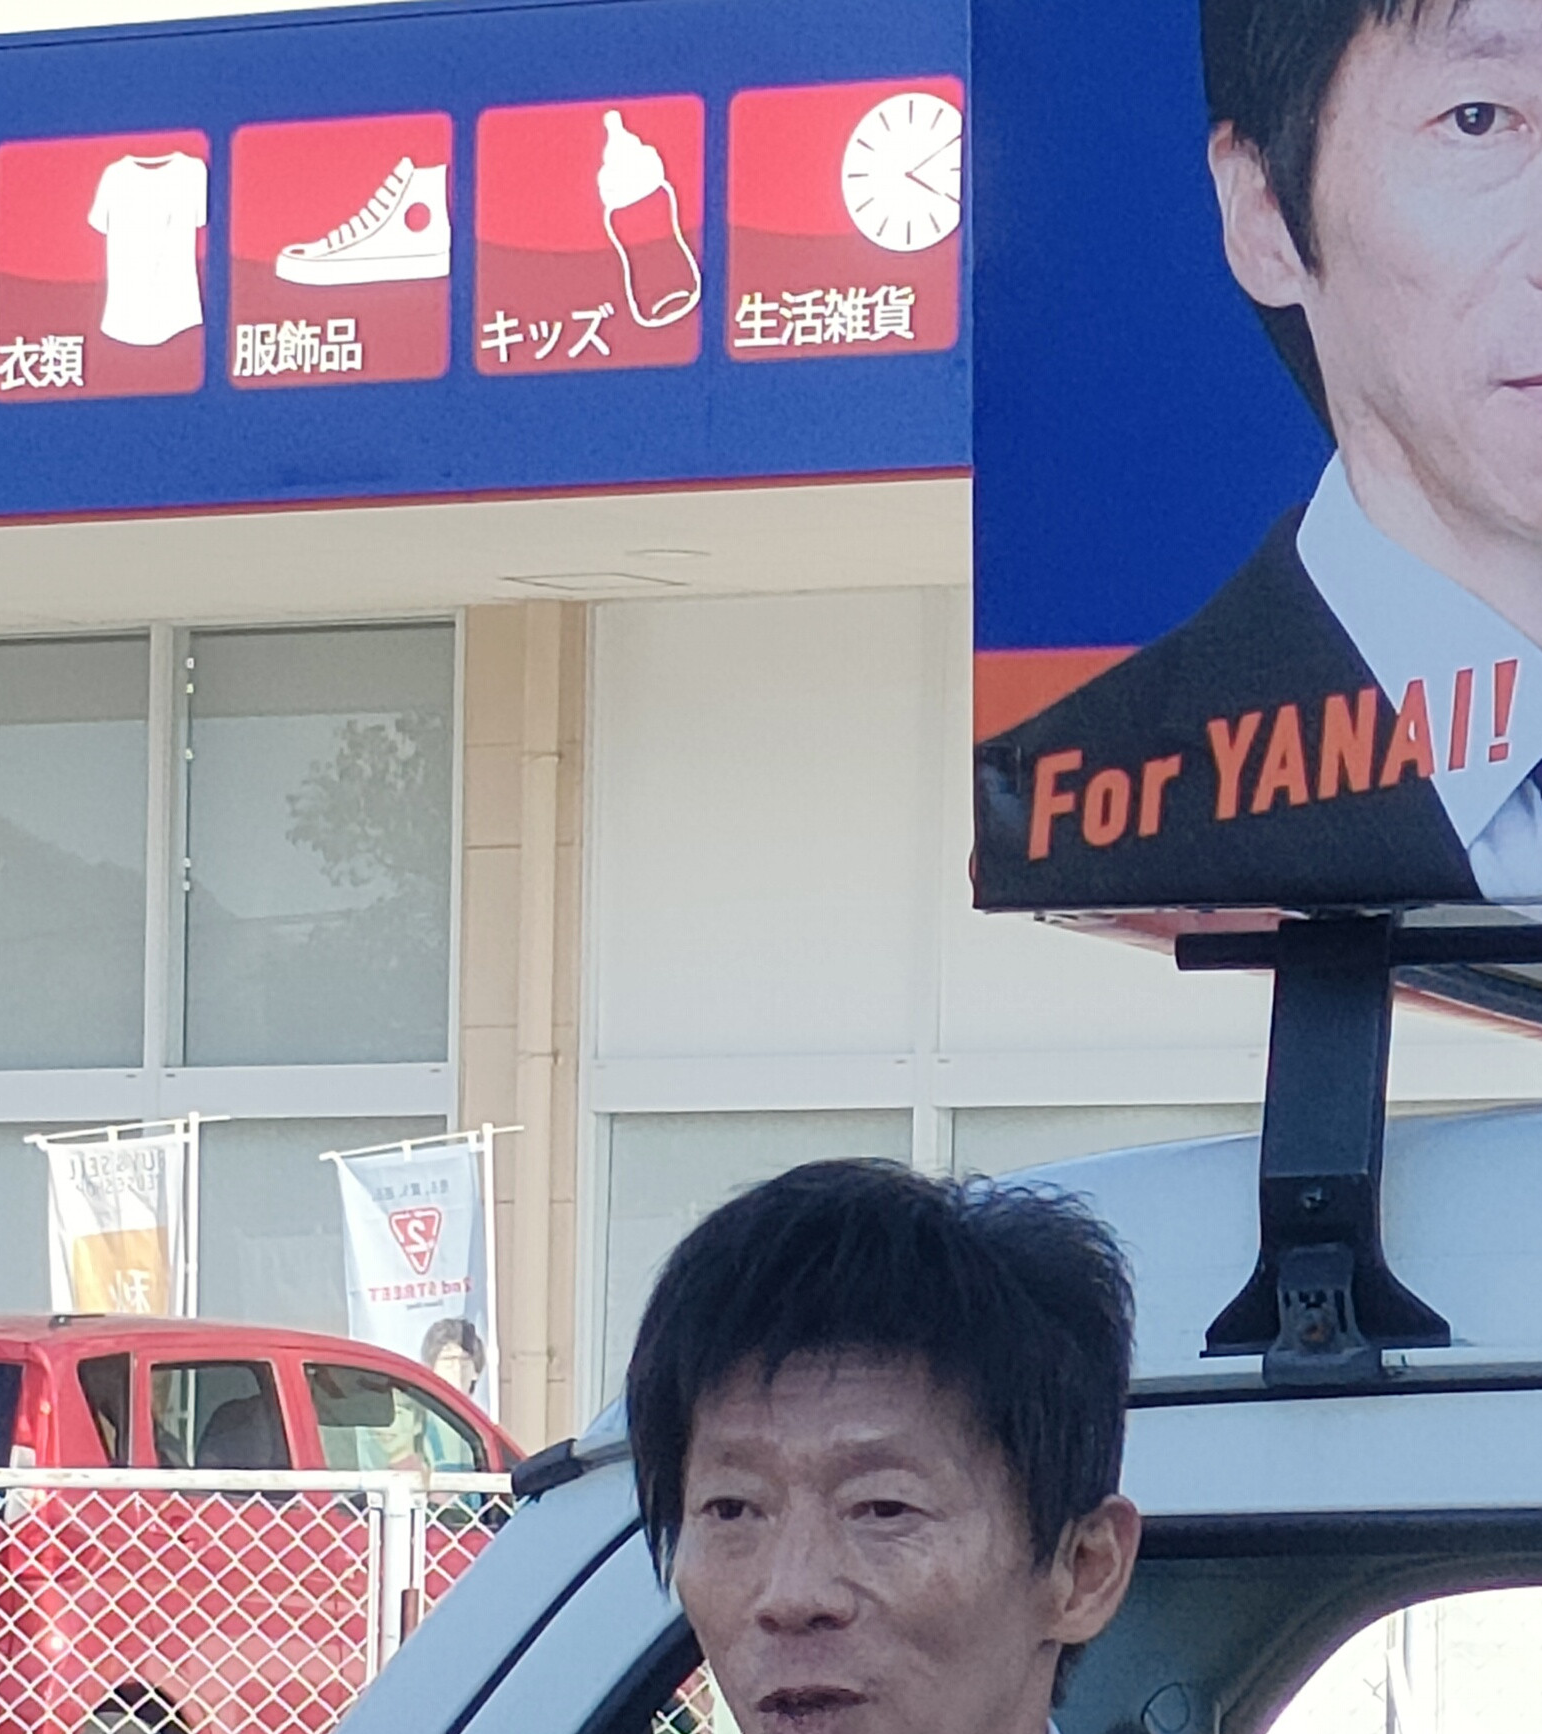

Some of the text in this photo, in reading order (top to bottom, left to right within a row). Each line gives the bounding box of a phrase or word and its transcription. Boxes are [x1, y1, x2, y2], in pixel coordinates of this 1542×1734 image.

[482, 307, 613, 363] キッズ
[735, 286, 916, 349] 生活雑貨
[233, 323, 362, 378] 服飾品
[1028, 656, 1519, 862] For YANAI!
